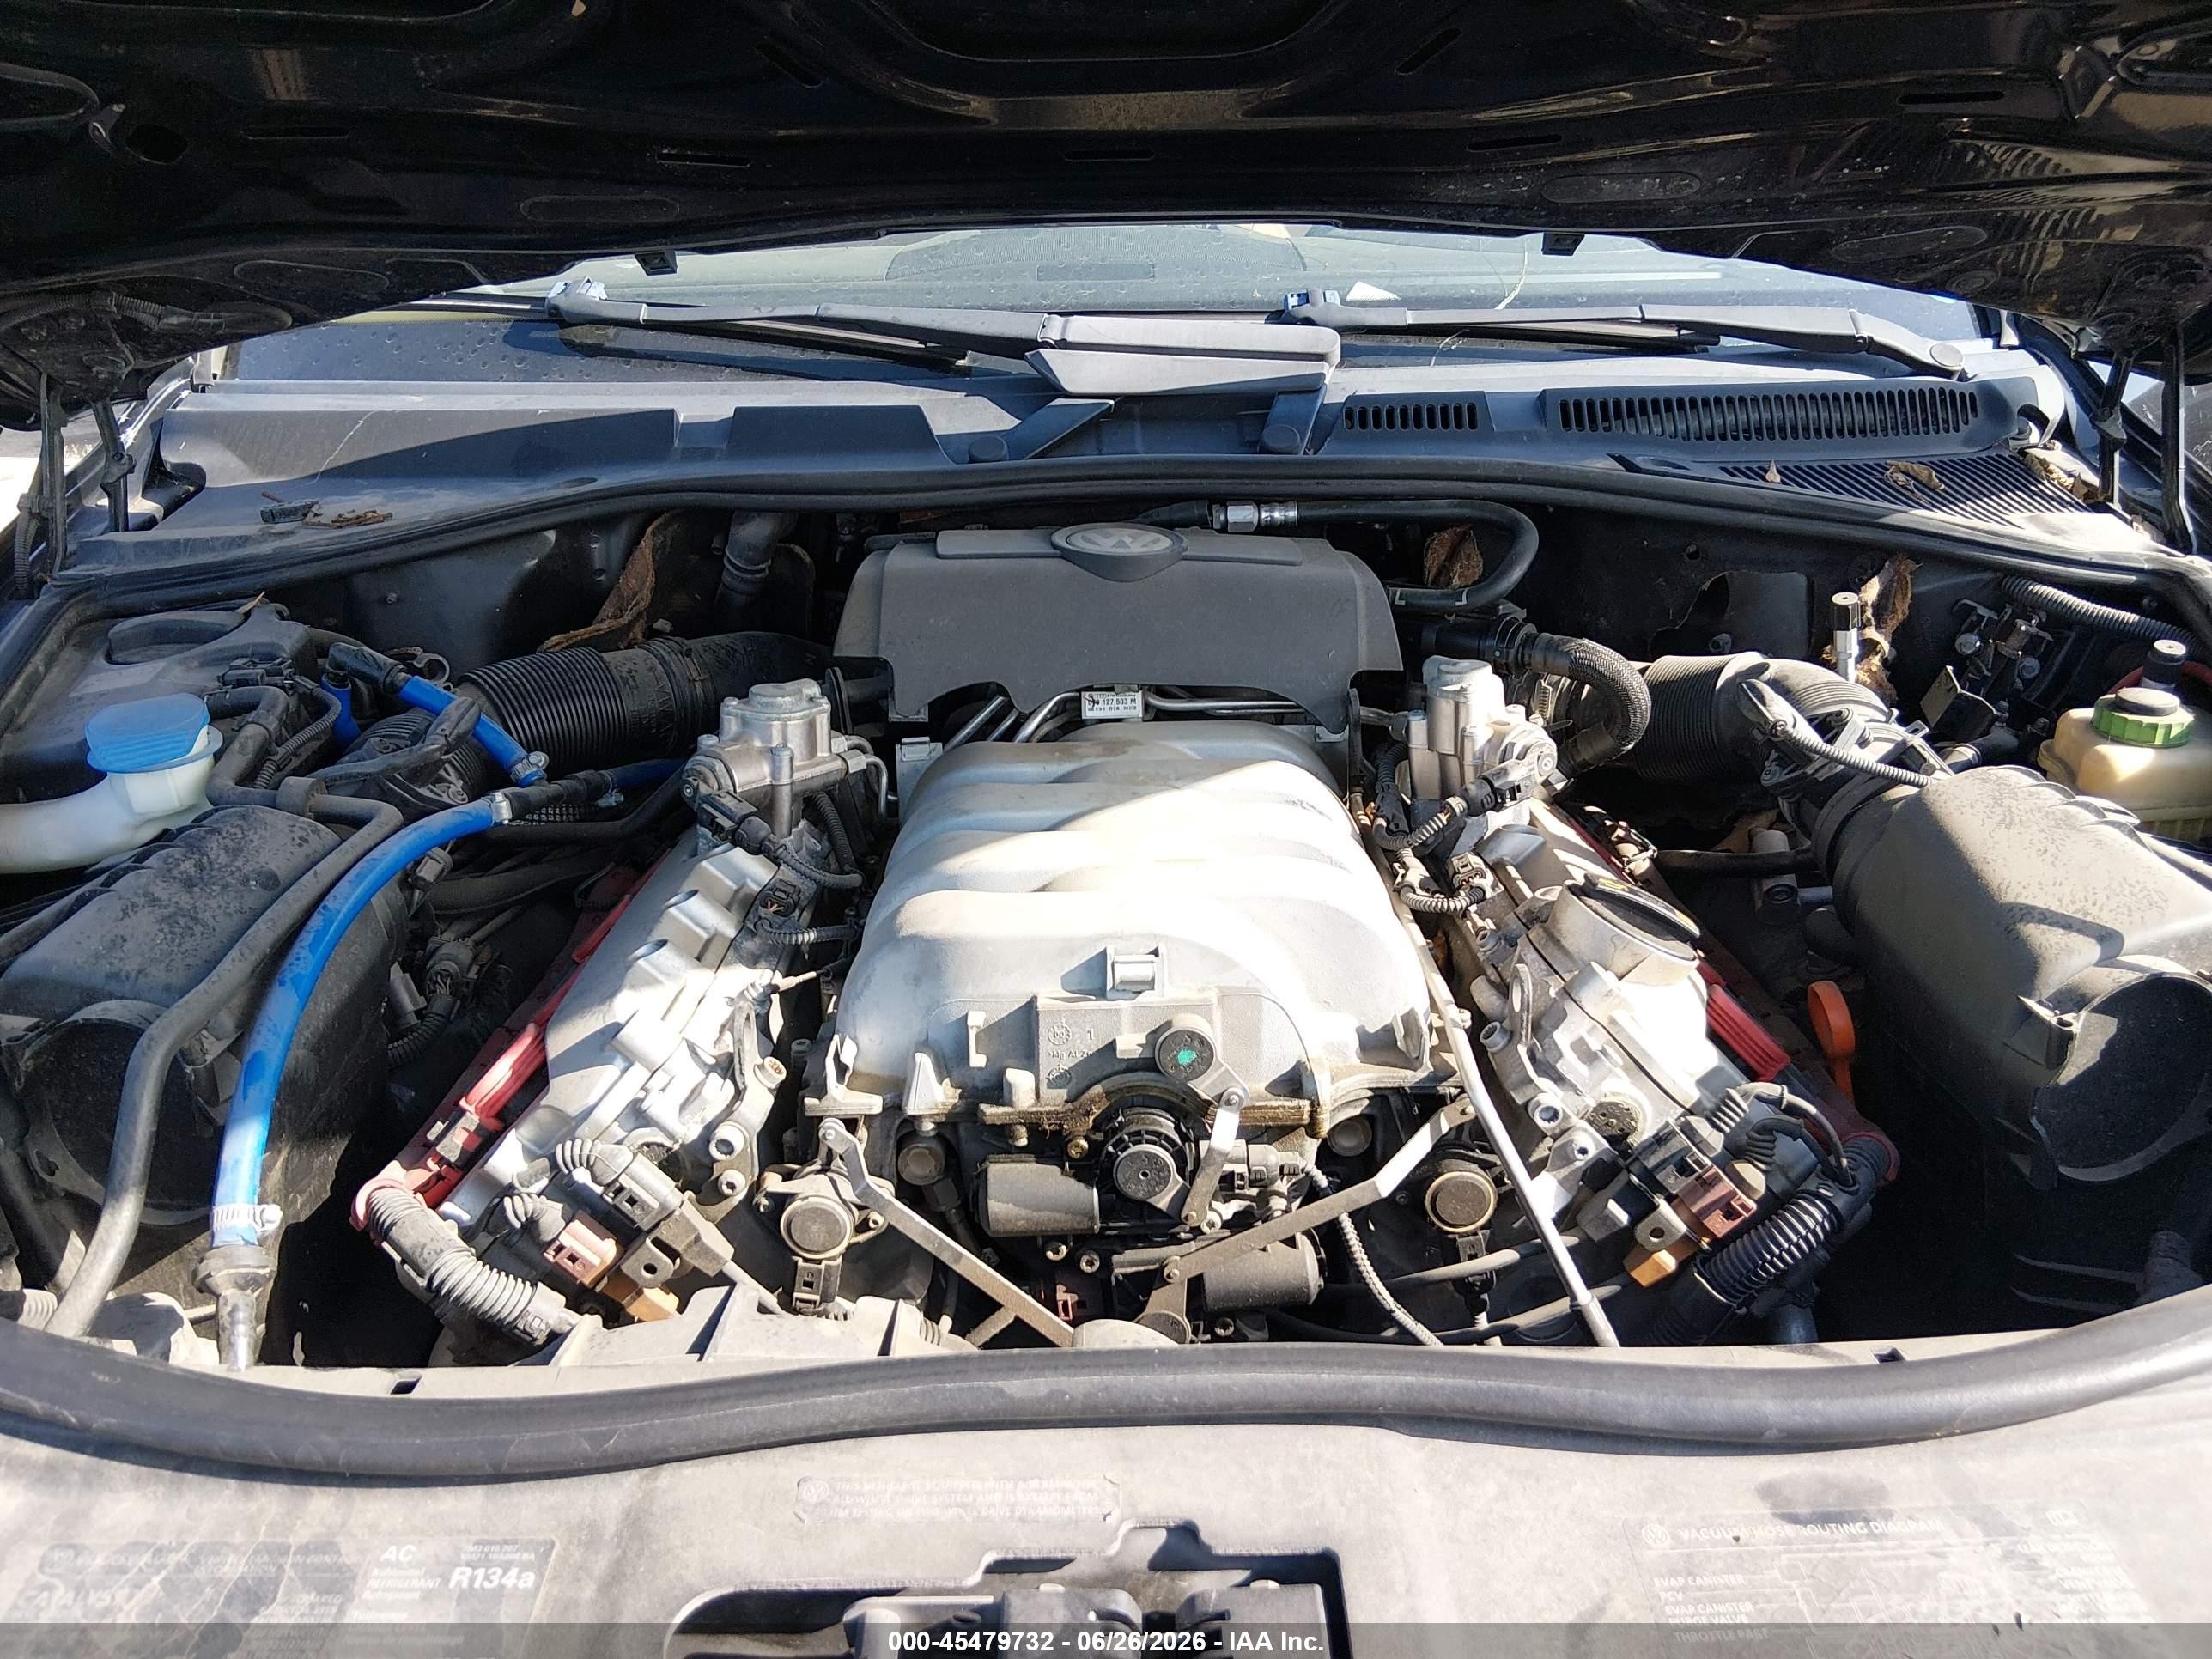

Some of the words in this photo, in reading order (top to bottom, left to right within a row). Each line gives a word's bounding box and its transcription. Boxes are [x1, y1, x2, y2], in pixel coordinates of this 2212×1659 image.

[1798, 1522, 1869, 1538] ROUTING
[1870, 1519, 1945, 1534] DIAGRAM
[380, 1545, 415, 1562] AC
[448, 1566, 536, 1589] R134a
